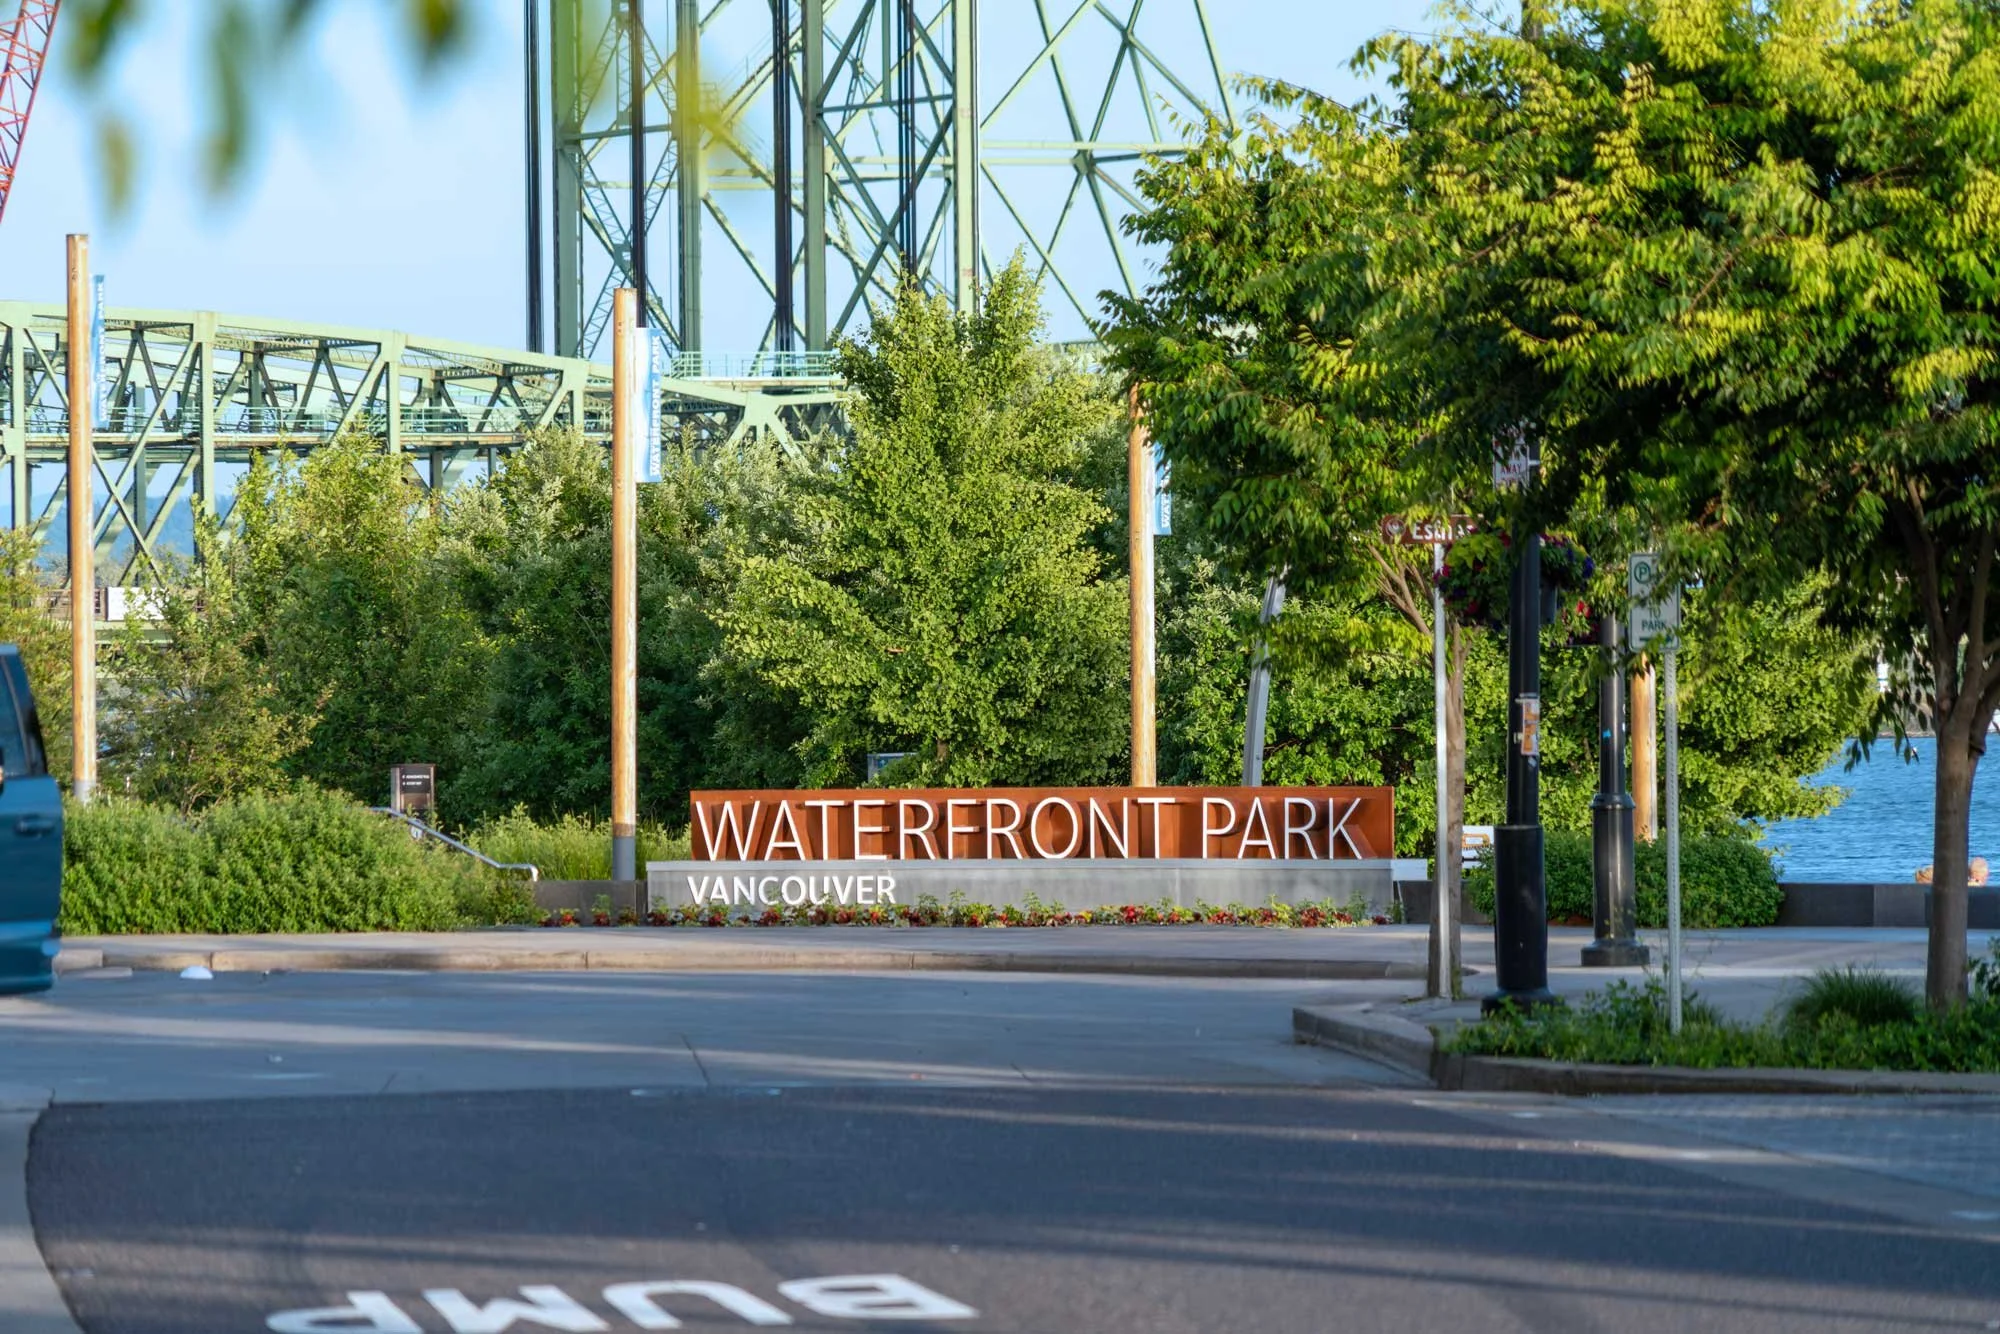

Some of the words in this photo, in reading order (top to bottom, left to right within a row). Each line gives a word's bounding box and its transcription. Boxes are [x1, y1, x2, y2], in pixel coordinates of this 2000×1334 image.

[97, 282, 105, 320] PARK
[651, 335, 661, 374] PARK
[651, 379, 662, 476] WATERFRONT
[1641, 620, 1667, 631] PARK
[695, 796, 1176, 861] WATERFRONT
[1202, 796, 1363, 860] PARK
[687, 875, 897, 906] VANCOUVER
[266, 1274, 979, 1334] BUMP
